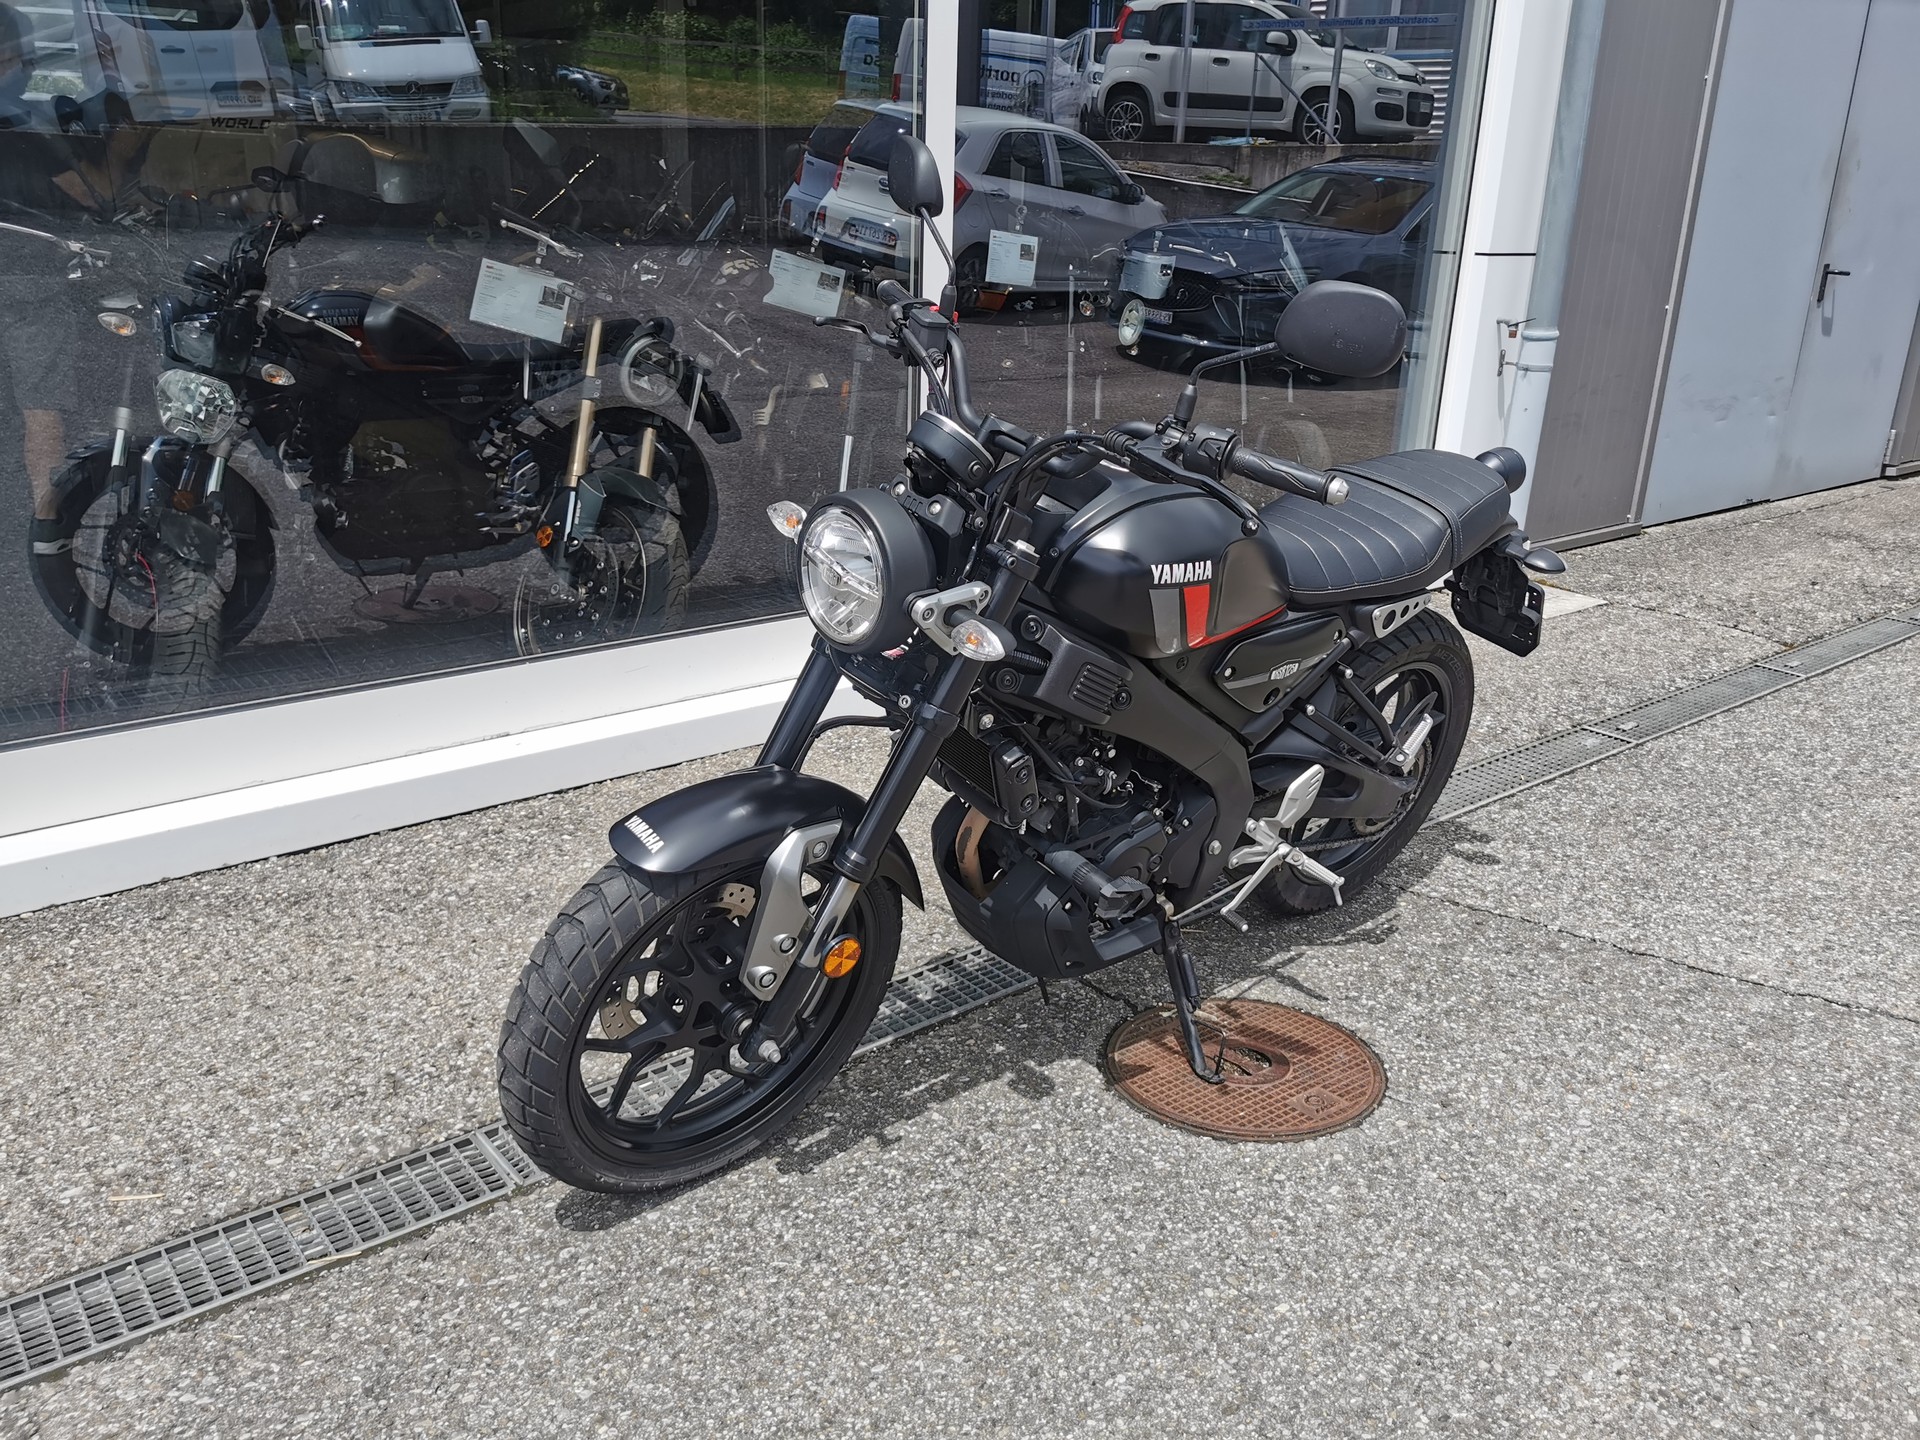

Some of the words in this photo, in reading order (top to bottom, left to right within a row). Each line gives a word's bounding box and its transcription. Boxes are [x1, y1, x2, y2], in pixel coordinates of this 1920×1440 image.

[211, 117, 272, 129] WORLD
[1150, 560, 1213, 585] YAMAHA
[623, 814, 665, 854] YAMAHA
